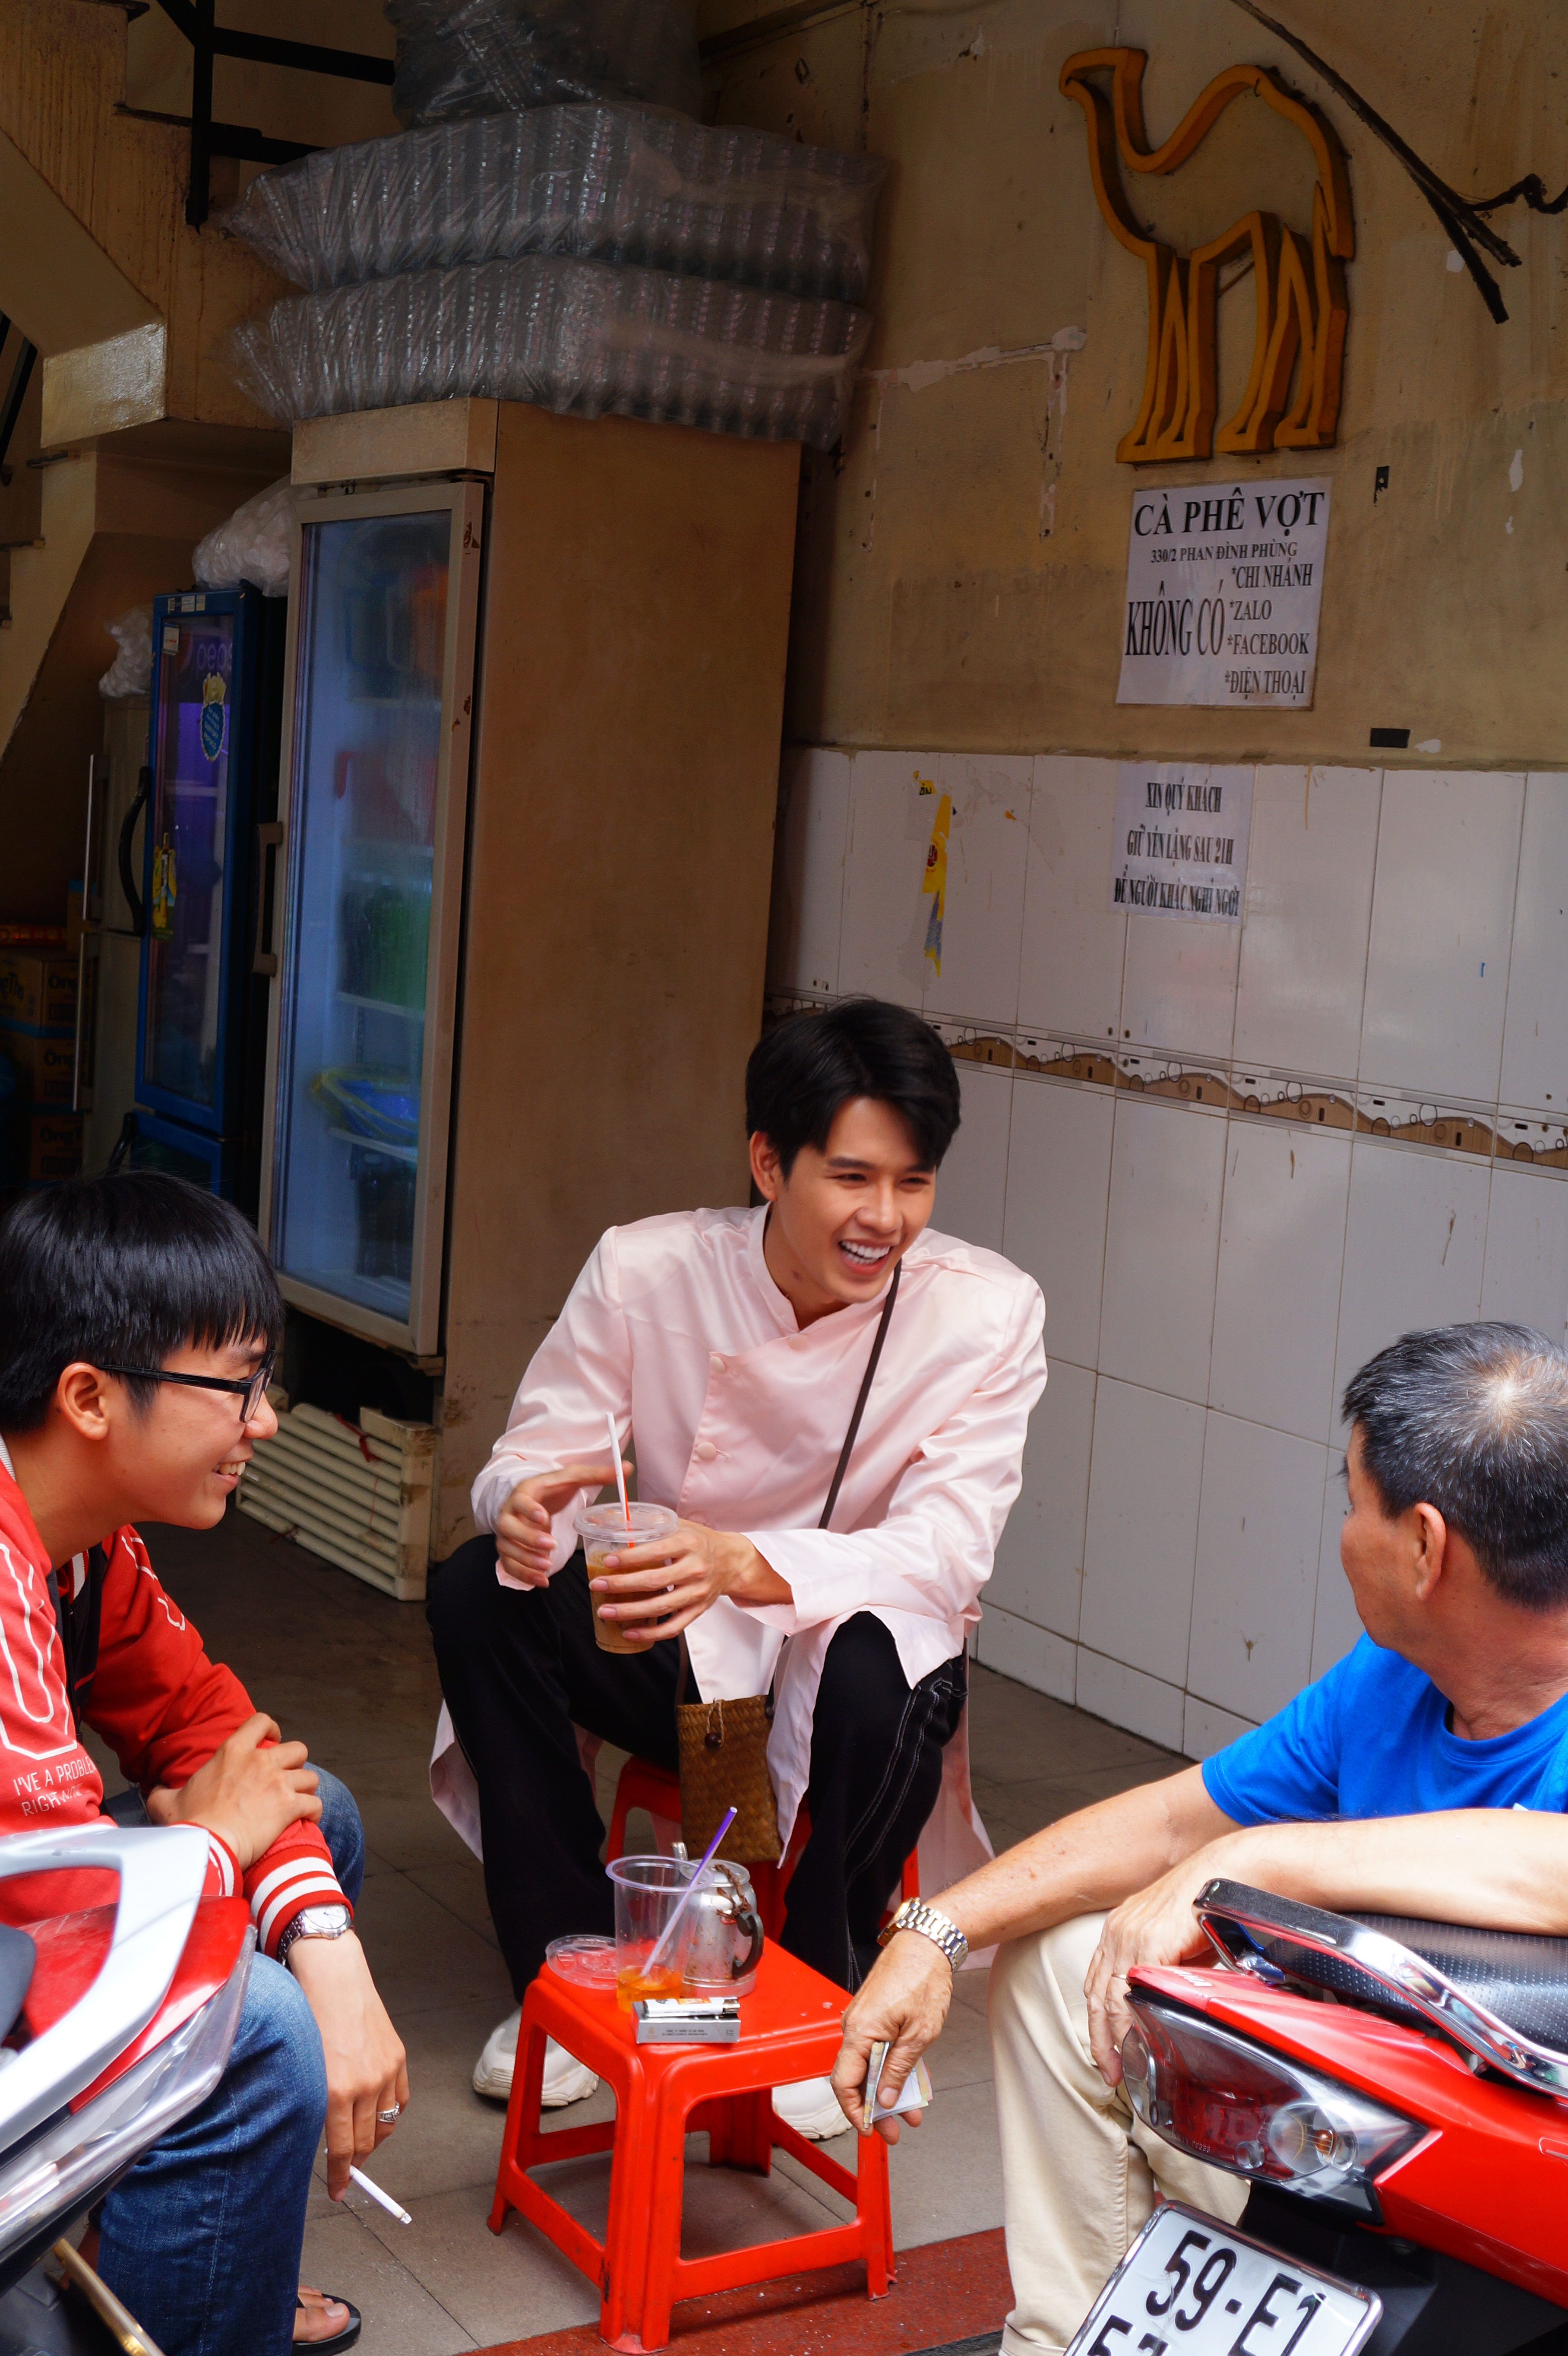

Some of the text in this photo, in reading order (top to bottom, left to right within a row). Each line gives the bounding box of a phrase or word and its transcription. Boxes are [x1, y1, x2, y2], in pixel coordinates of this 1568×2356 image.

[1135, 487, 1325, 536] CÀ PHÊ VỢT
[1151, 538, 1298, 563] 330/2 PHAN ĐÌNH PHÙNG
[1263, 557, 1314, 587] NHÁNH
[1125, 579, 1225, 656] KHÔNG CÓ
[1265, 671, 1307, 700] THOẠI
[1145, 776, 1223, 816] XIN QUÝ KHÁCH
[1127, 823, 1145, 856] GIỮ
[1147, 825, 1165, 858] YÊN
[1193, 836, 1214, 863] SAU
[1216, 837, 1234, 864] 21H
[1159, 877, 1187, 911] KHÁC
[13, 1772, 41, 1796] I'VE
[45, 1769, 54, 1787] A
[21, 1792, 61, 1817] RIGHT
